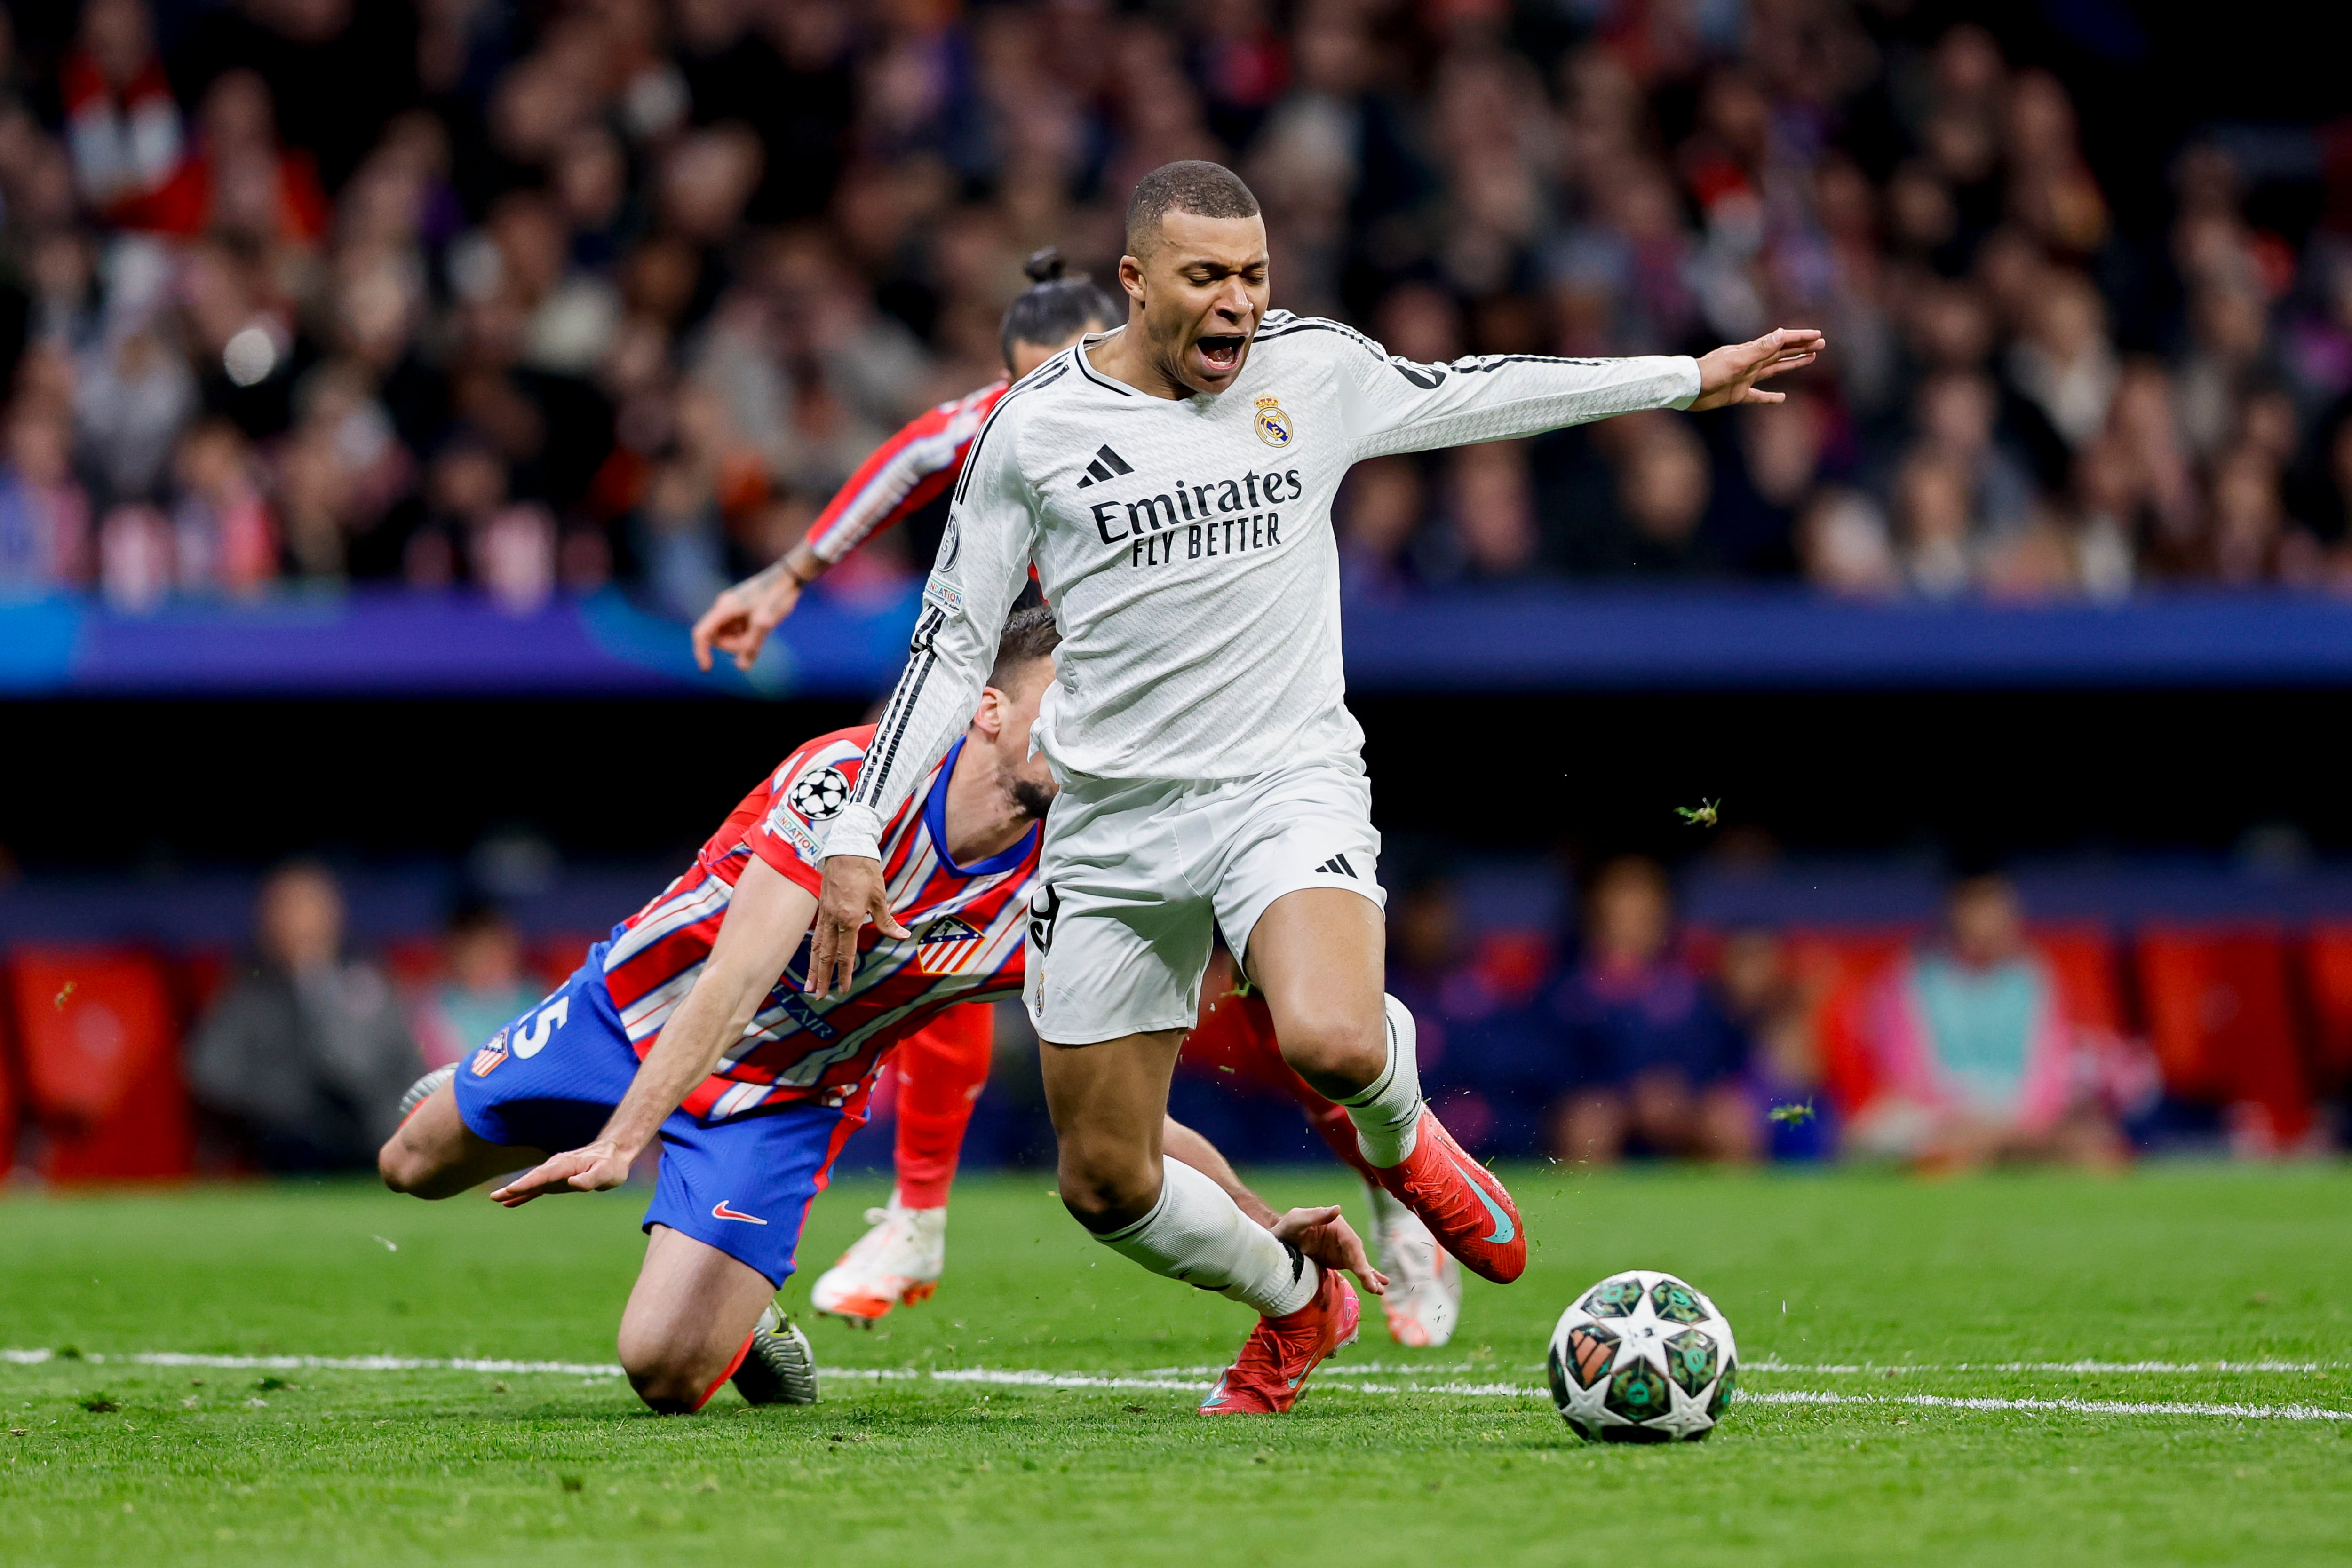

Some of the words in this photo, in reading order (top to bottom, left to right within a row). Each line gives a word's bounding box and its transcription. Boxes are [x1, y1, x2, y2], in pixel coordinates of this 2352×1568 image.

[1090, 469, 1302, 545] Emirates
[1133, 531, 1175, 567] FLY
[1188, 512, 1281, 560] BETTER
[790, 1009, 832, 1037] AIR
